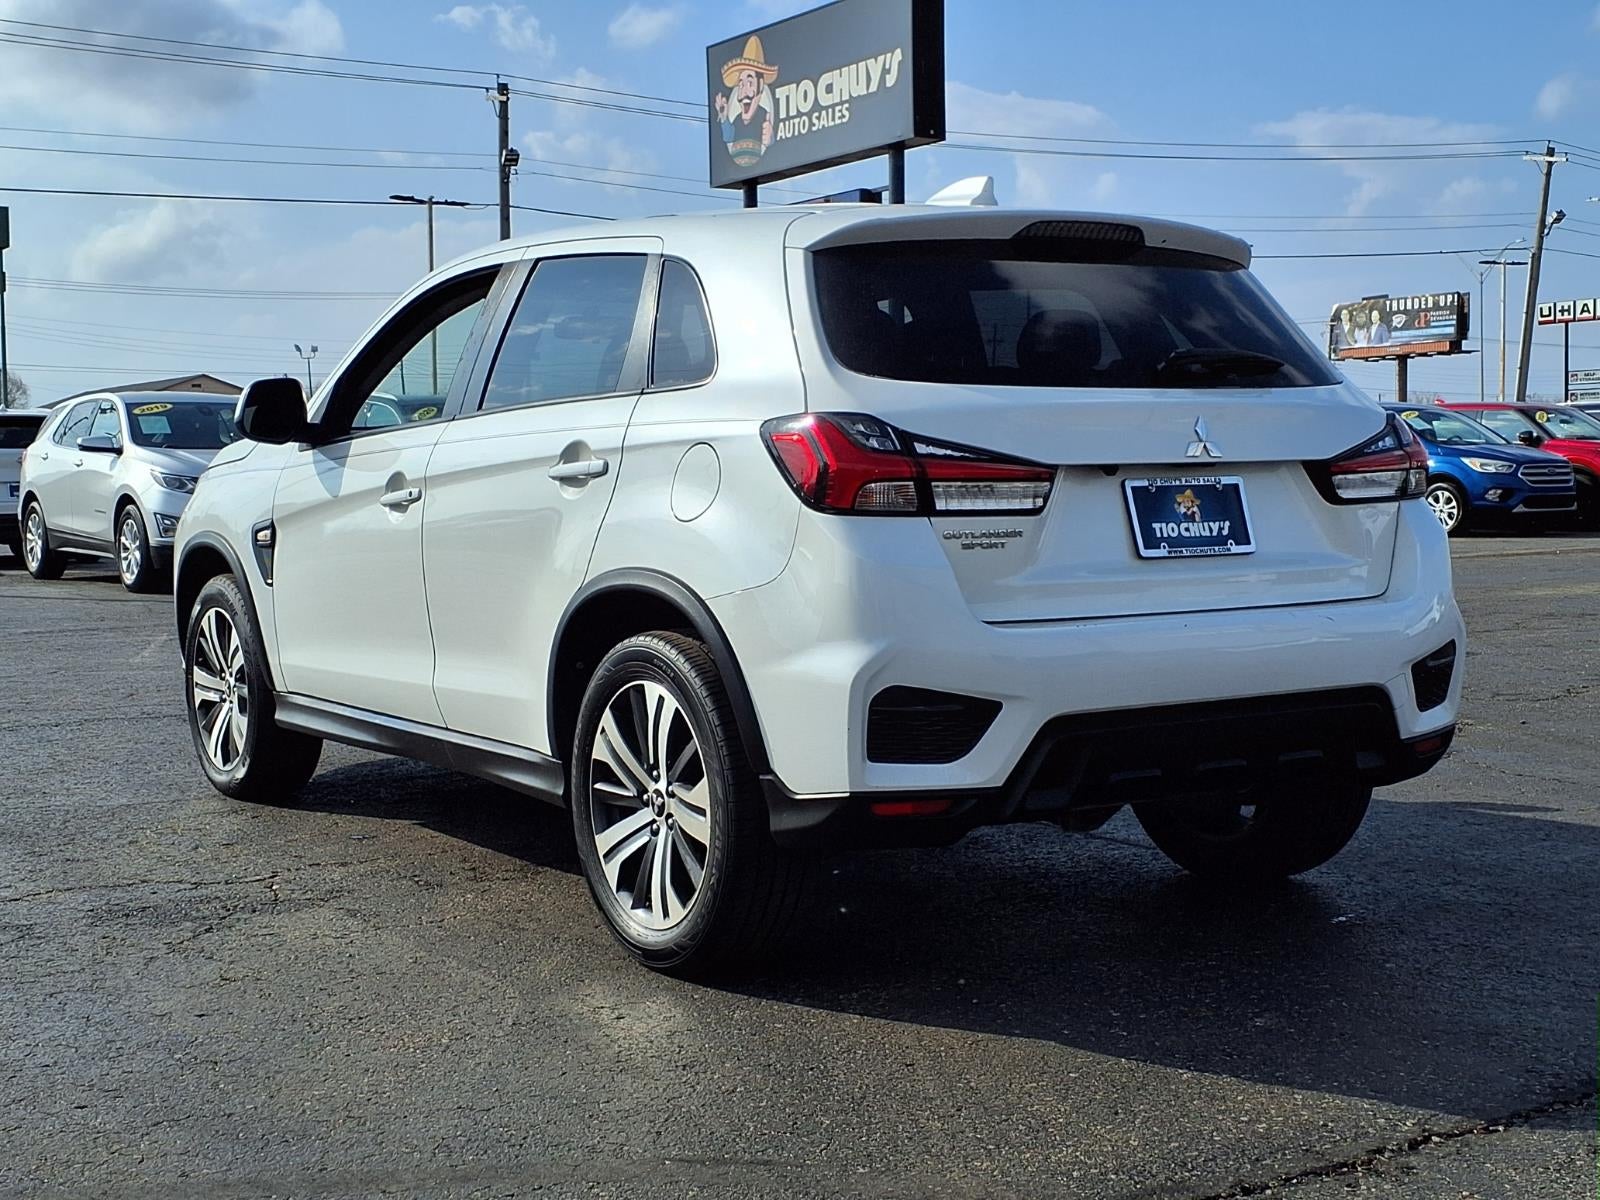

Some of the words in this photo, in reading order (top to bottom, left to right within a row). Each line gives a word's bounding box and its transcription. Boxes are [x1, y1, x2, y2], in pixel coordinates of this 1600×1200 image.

[775, 79, 815, 120] TIO
[817, 48, 902, 107] CHUY'S
[777, 115, 809, 141] AUTO
[812, 103, 850, 131] SALES
[1385, 296, 1434, 312] THUNDER
[1439, 293, 1458, 307] UP!
[943, 528, 1024, 540] OUTLANDER
[1152, 522, 1179, 538] TIO
[1179, 520, 1231, 537] CHUY'S
[961, 539, 1008, 550] SPORT
[1167, 546, 1232, 556] WWW.TIOCHUYS.COM
